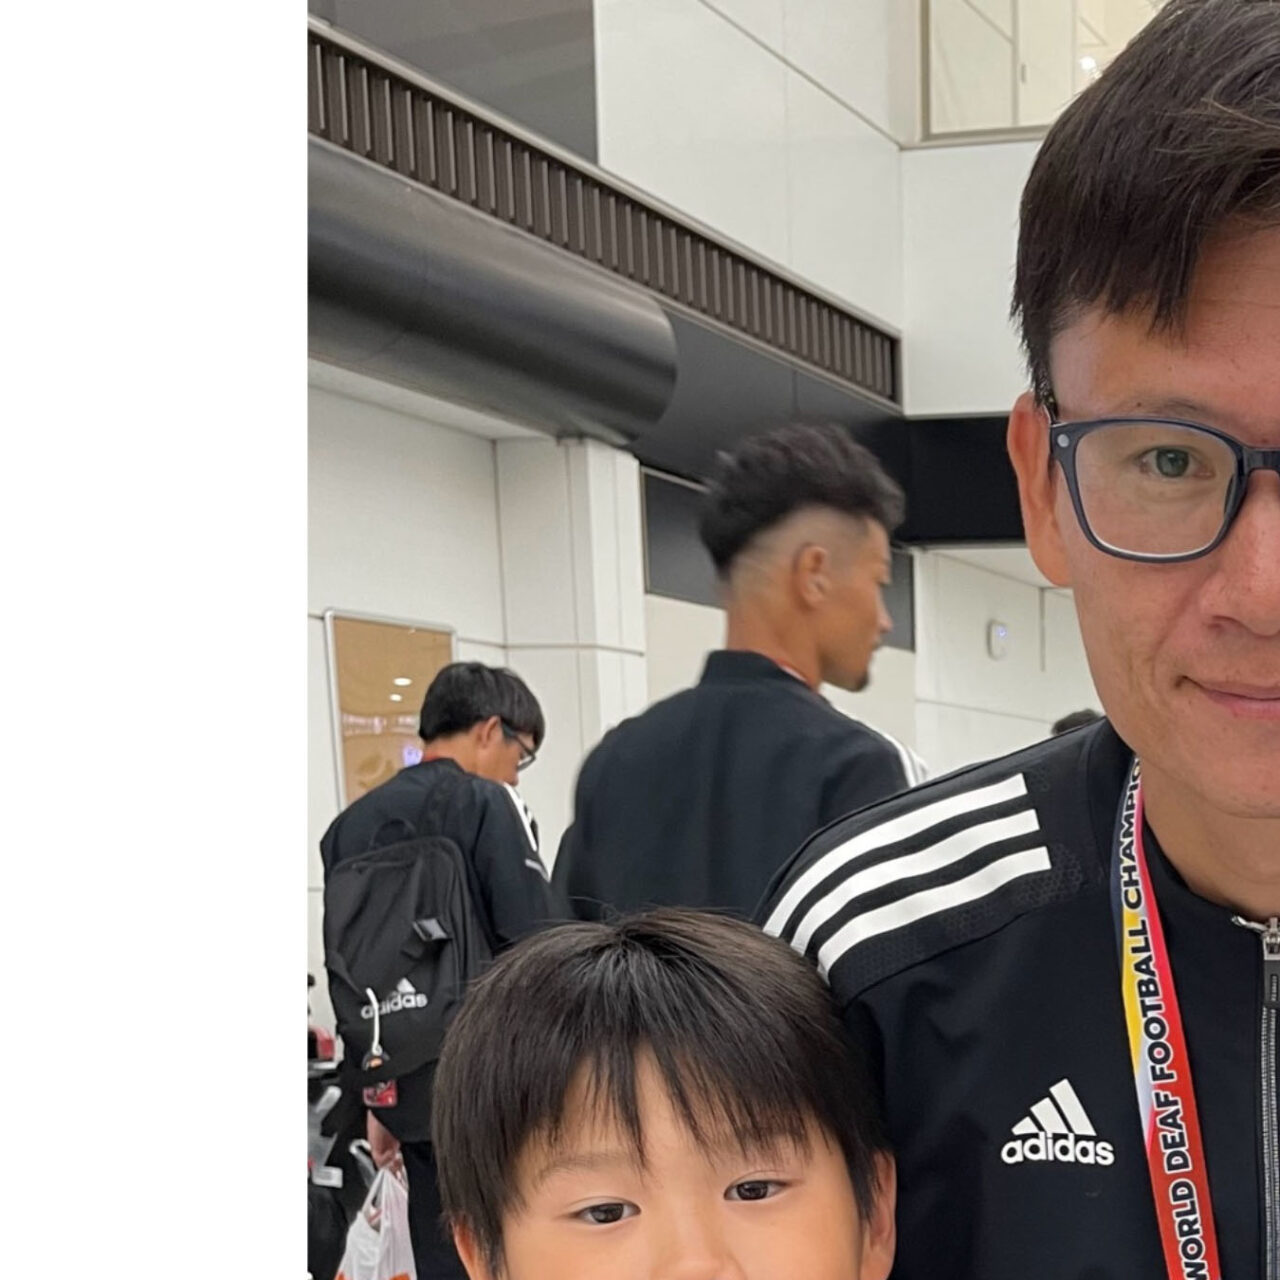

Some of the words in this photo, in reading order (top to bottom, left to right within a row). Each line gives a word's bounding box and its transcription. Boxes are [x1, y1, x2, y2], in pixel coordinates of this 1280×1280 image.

[1130, 918, 1176, 1083] FOOTBALL
[1001, 1131, 1115, 1166] adidas
[1154, 1091, 1193, 1174] DEAF
